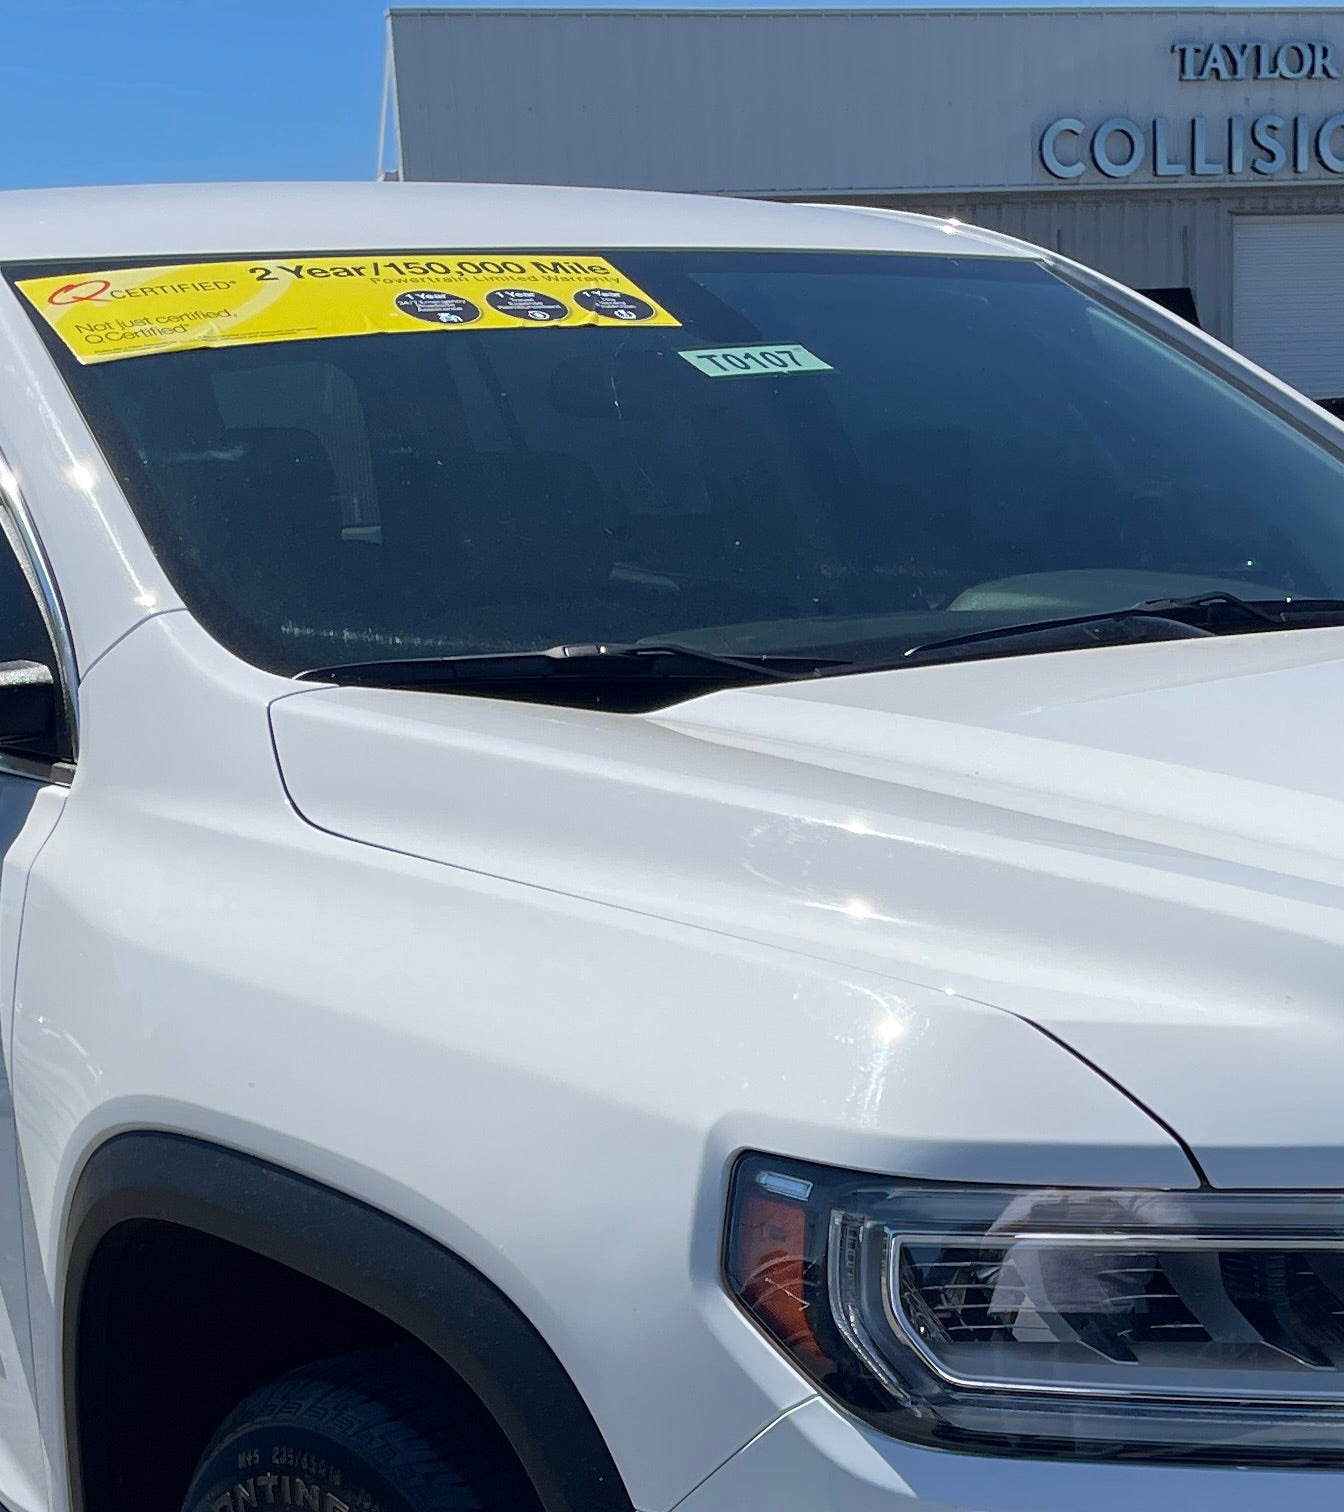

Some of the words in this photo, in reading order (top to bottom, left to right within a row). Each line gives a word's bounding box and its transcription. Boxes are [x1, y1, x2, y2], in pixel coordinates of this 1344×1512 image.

[1170, 40, 1338, 81] TAYLOR
[249, 266, 279, 281] 2
[530, 261, 611, 275] Mile
[369, 275, 469, 285] Powertrain
[472, 275, 540, 283] Limited
[544, 275, 621, 284] Warranty
[74, 321, 115, 334] Not
[116, 316, 153, 330] just
[696, 350, 803, 371] T0107
